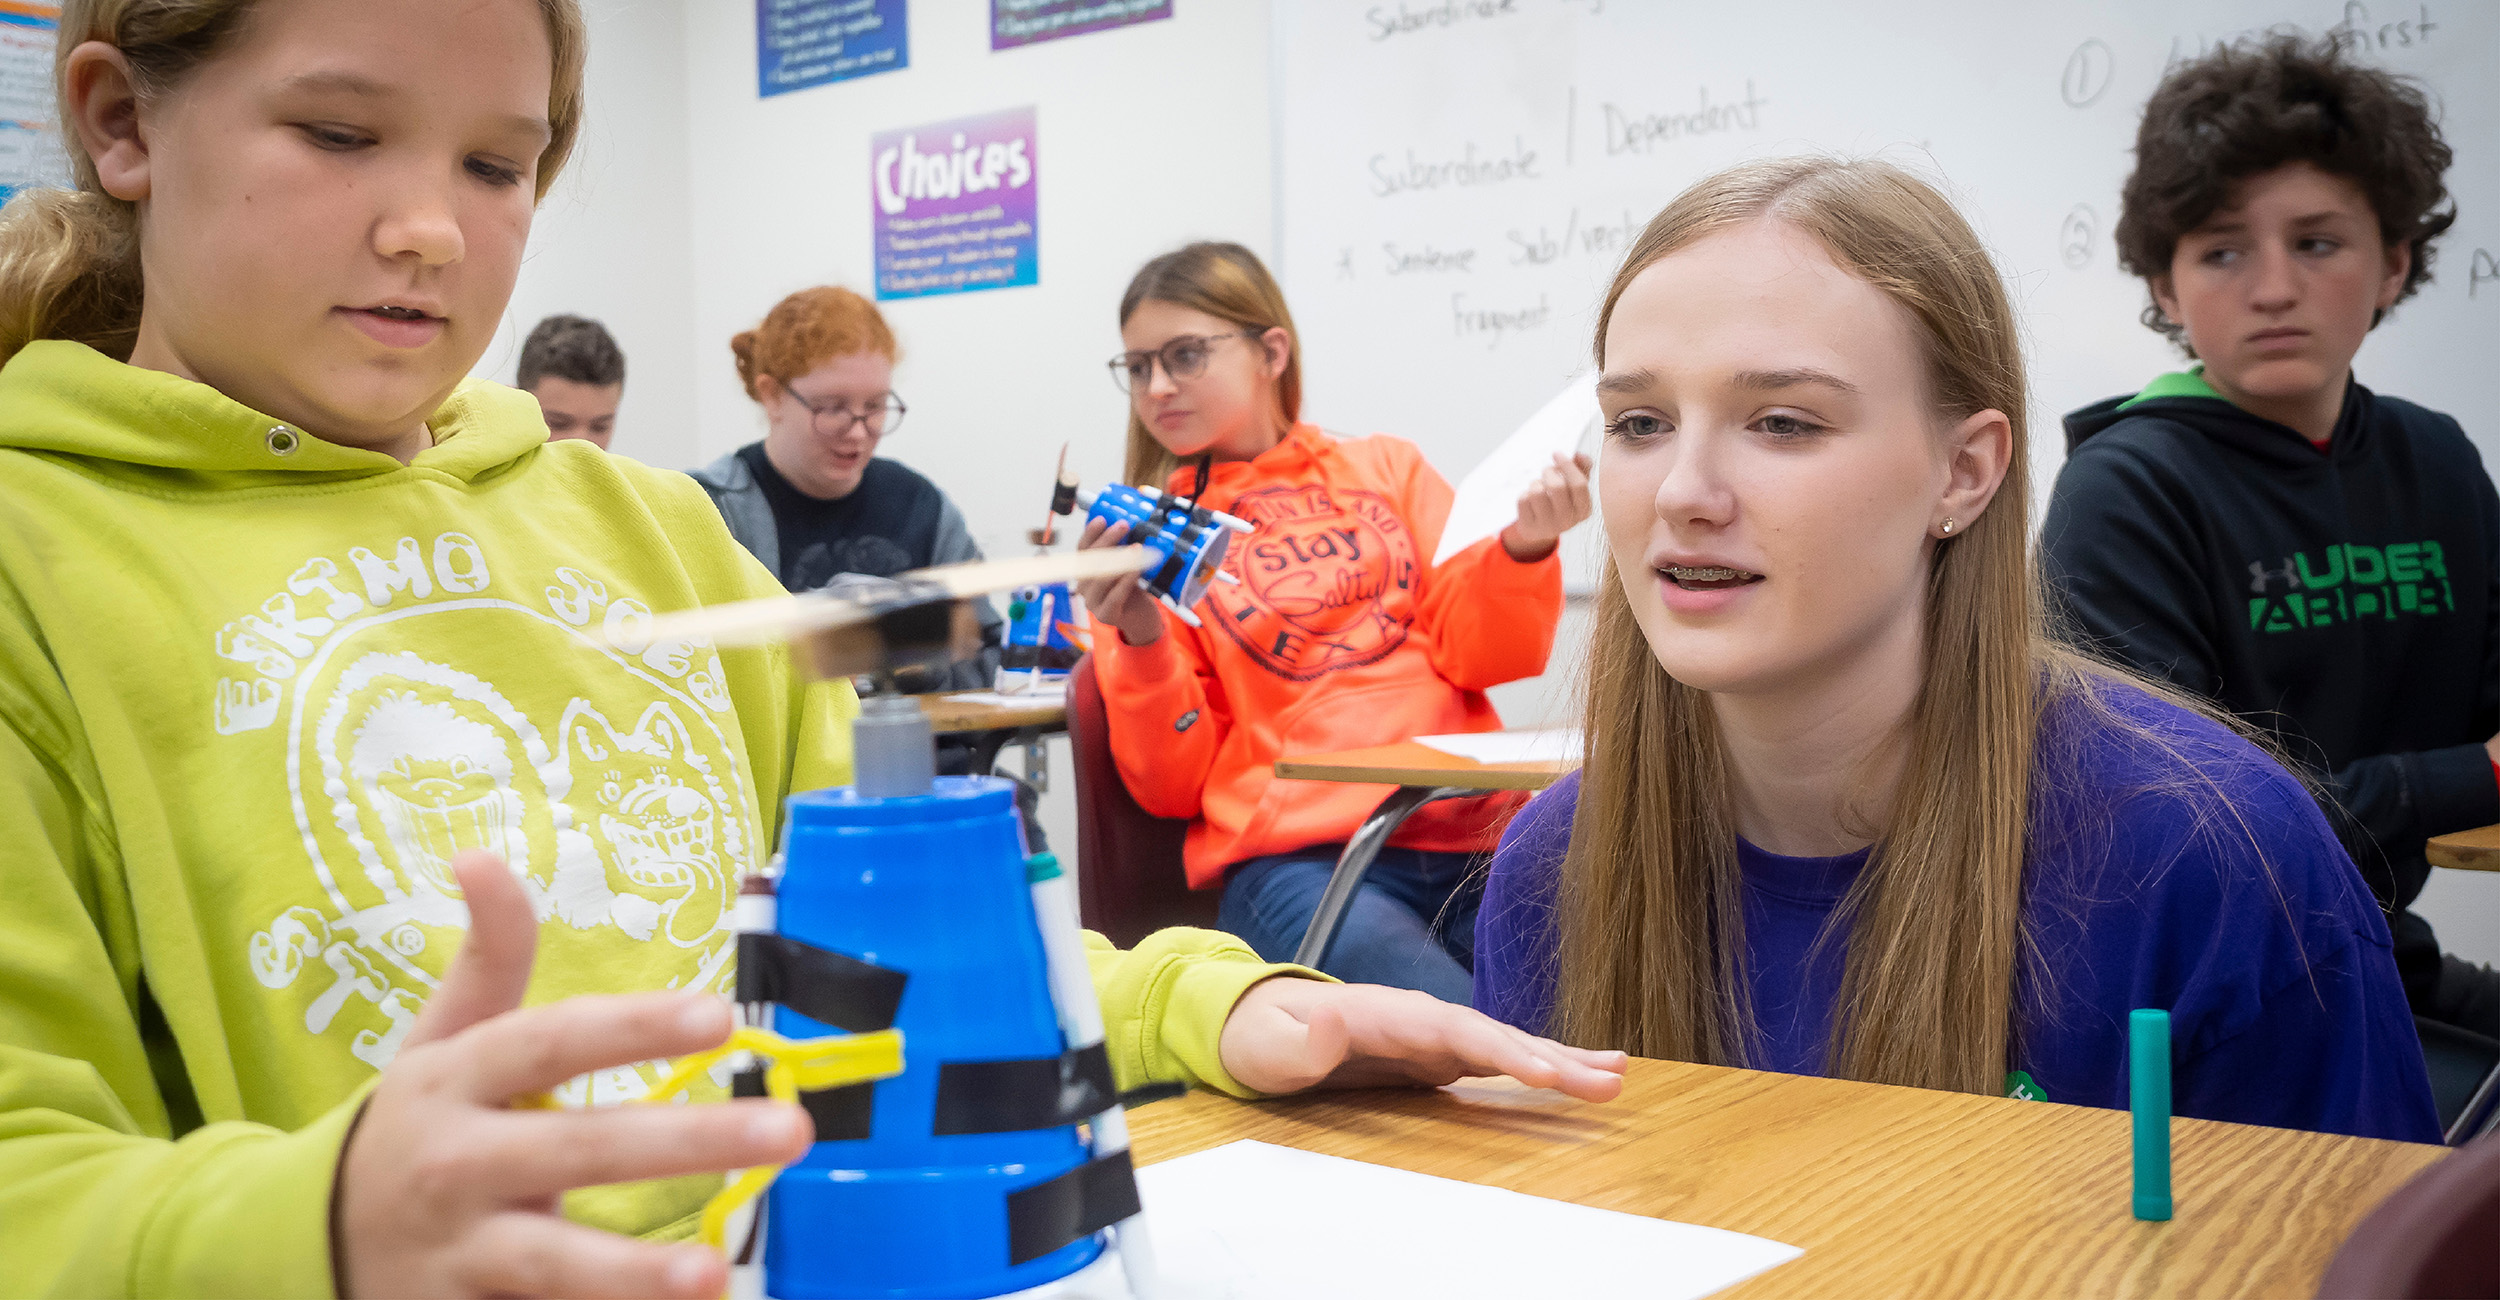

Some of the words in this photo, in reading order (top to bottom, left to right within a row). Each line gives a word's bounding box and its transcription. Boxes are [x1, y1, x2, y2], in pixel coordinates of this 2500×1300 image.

[876, 133, 1032, 215] Choices
[1368, 136, 1544, 199] Subordinate
[1601, 78, 1769, 157] Dependent
[1306, 492, 1398, 533] ISAND
[2293, 540, 2448, 590] UDER
[214, 532, 491, 736] ESKIMO
